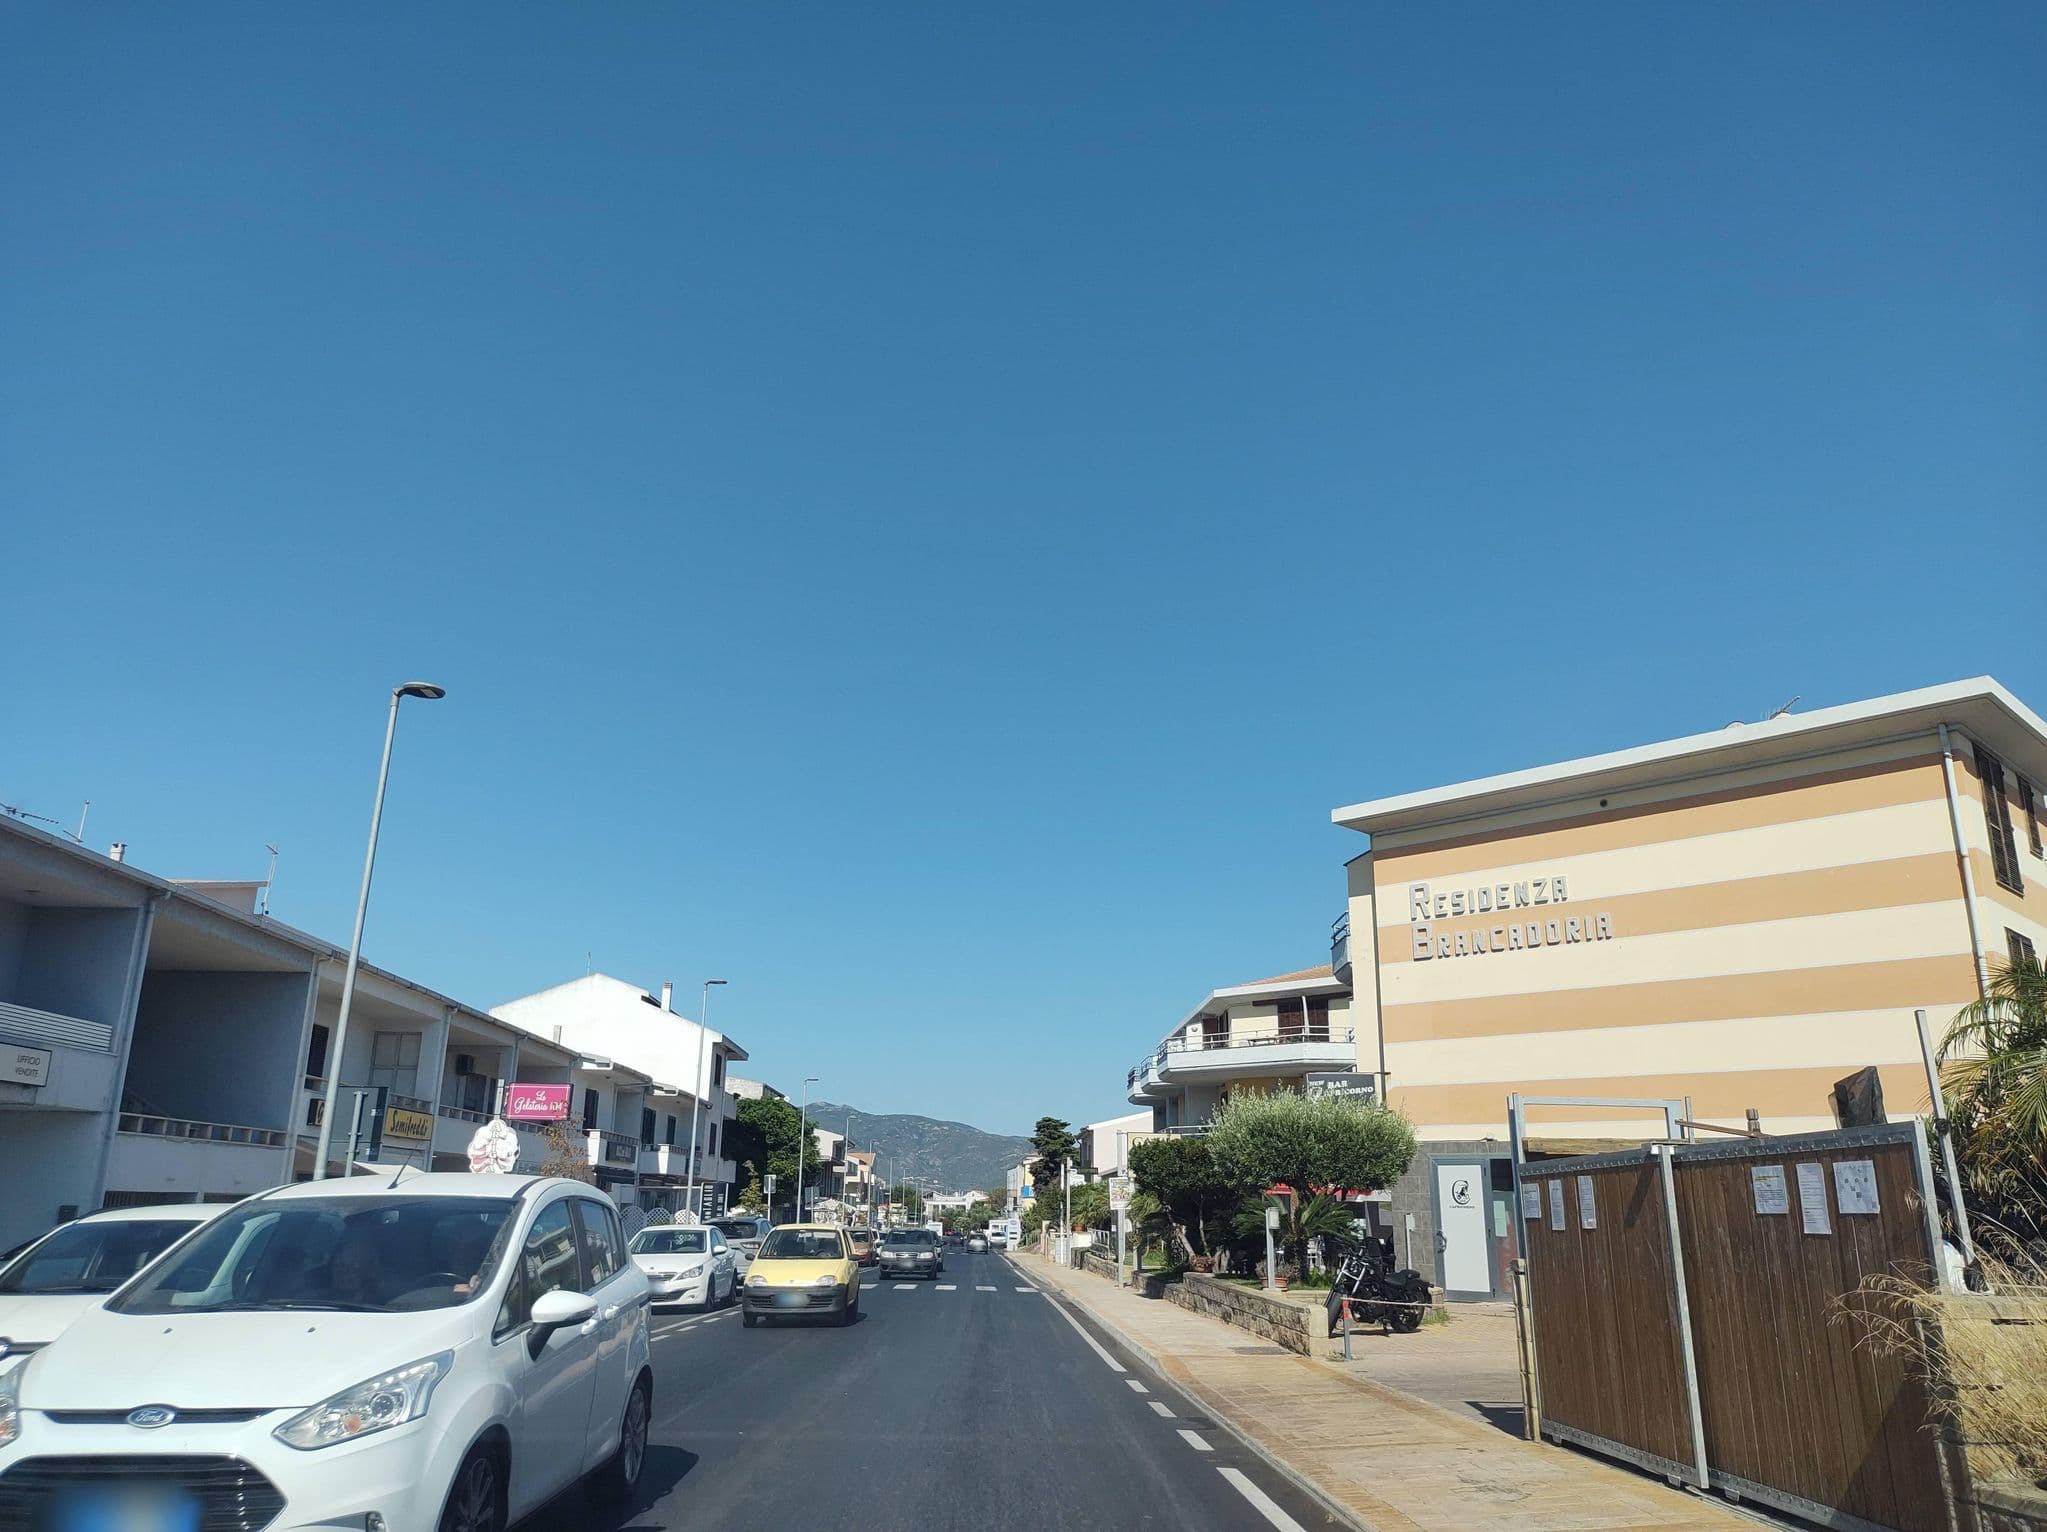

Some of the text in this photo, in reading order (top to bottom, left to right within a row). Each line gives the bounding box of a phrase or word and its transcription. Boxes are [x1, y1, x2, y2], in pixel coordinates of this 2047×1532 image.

[1409, 875, 1569, 921] RESIDENZA
[16, 1054, 41, 1066] UFFICIO
[15, 1066, 39, 1078] VENDITE
[1327, 1080, 1348, 1089] BAR
[535, 1090, 547, 1101] La
[514, 1096, 548, 1114] Gelateria
[134, 1409, 163, 1423] Ford
